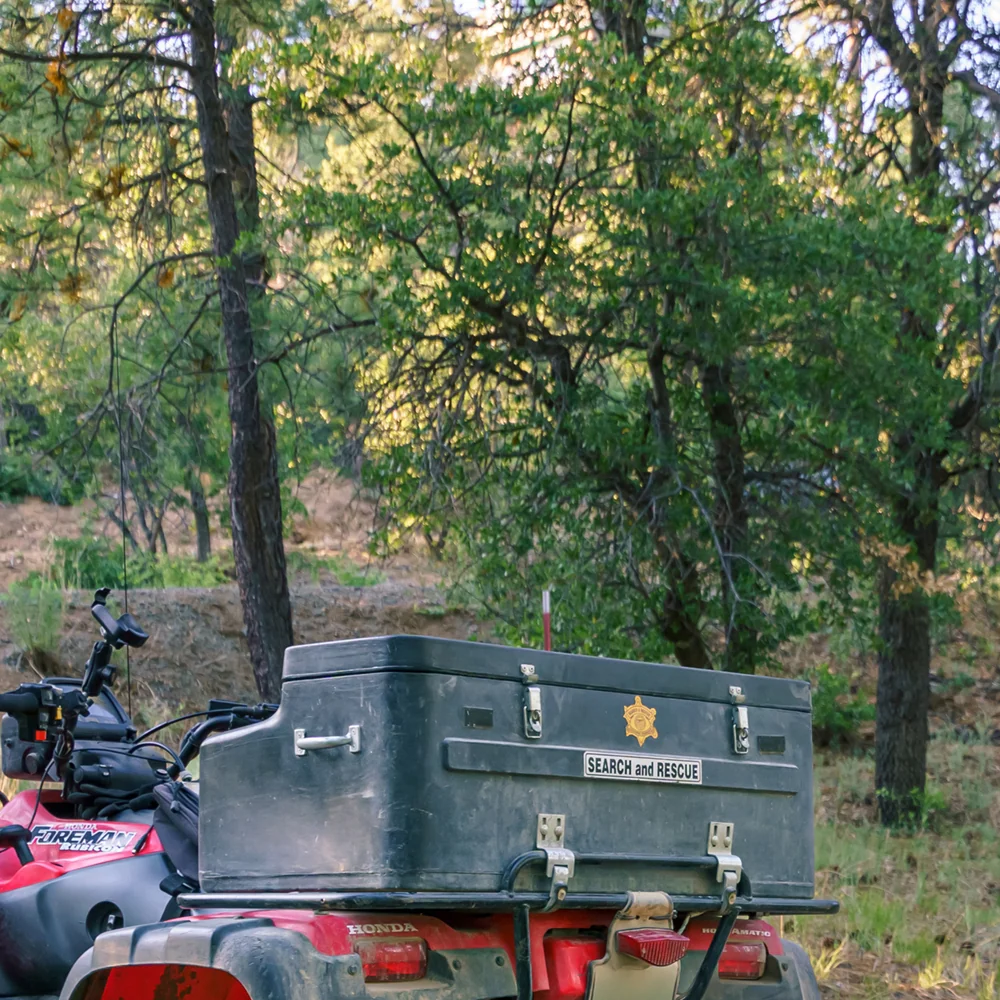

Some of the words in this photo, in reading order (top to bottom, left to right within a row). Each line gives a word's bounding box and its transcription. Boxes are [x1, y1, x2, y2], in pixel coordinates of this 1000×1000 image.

[588, 757, 632, 775] SEARCH
[635, 761, 654, 777] and
[657, 763, 698, 779] RESCUE
[28, 824, 137, 848] FOREMAN
[346, 923, 419, 935] HONDA
[702, 928, 771, 937] HOAMATIC
